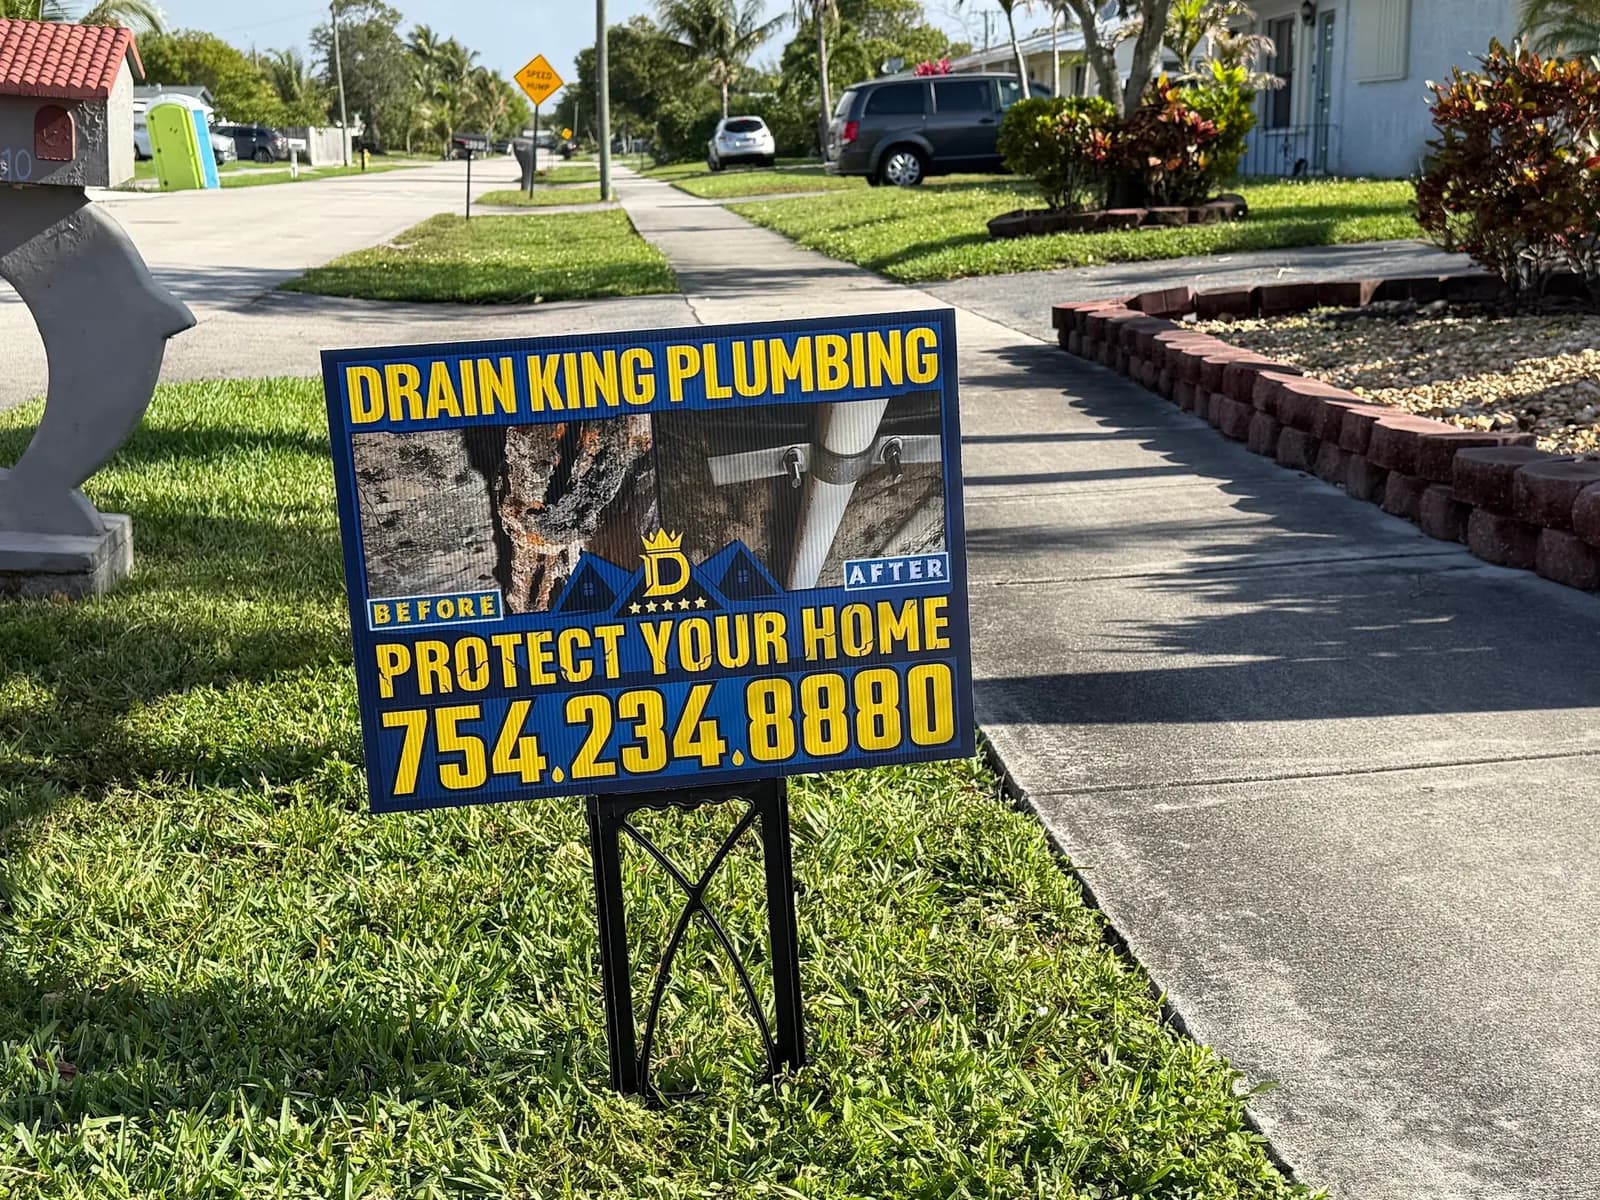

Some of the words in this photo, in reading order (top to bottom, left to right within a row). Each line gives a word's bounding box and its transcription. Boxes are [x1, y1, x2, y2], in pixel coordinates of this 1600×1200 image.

[526, 69, 552, 80] SPEED
[526, 82, 550, 91] HUMP
[346, 356, 517, 424] DRAIN
[526, 347, 656, 413] KING
[666, 327, 939, 402] PLUMBING
[848, 558, 944, 586] AFTER
[372, 595, 497, 625] BEFORE
[375, 623, 626, 699] PROTECT
[639, 611, 789, 676] YOUR
[802, 596, 951, 662] HOME
[381, 663, 955, 796] 754.234.8880
